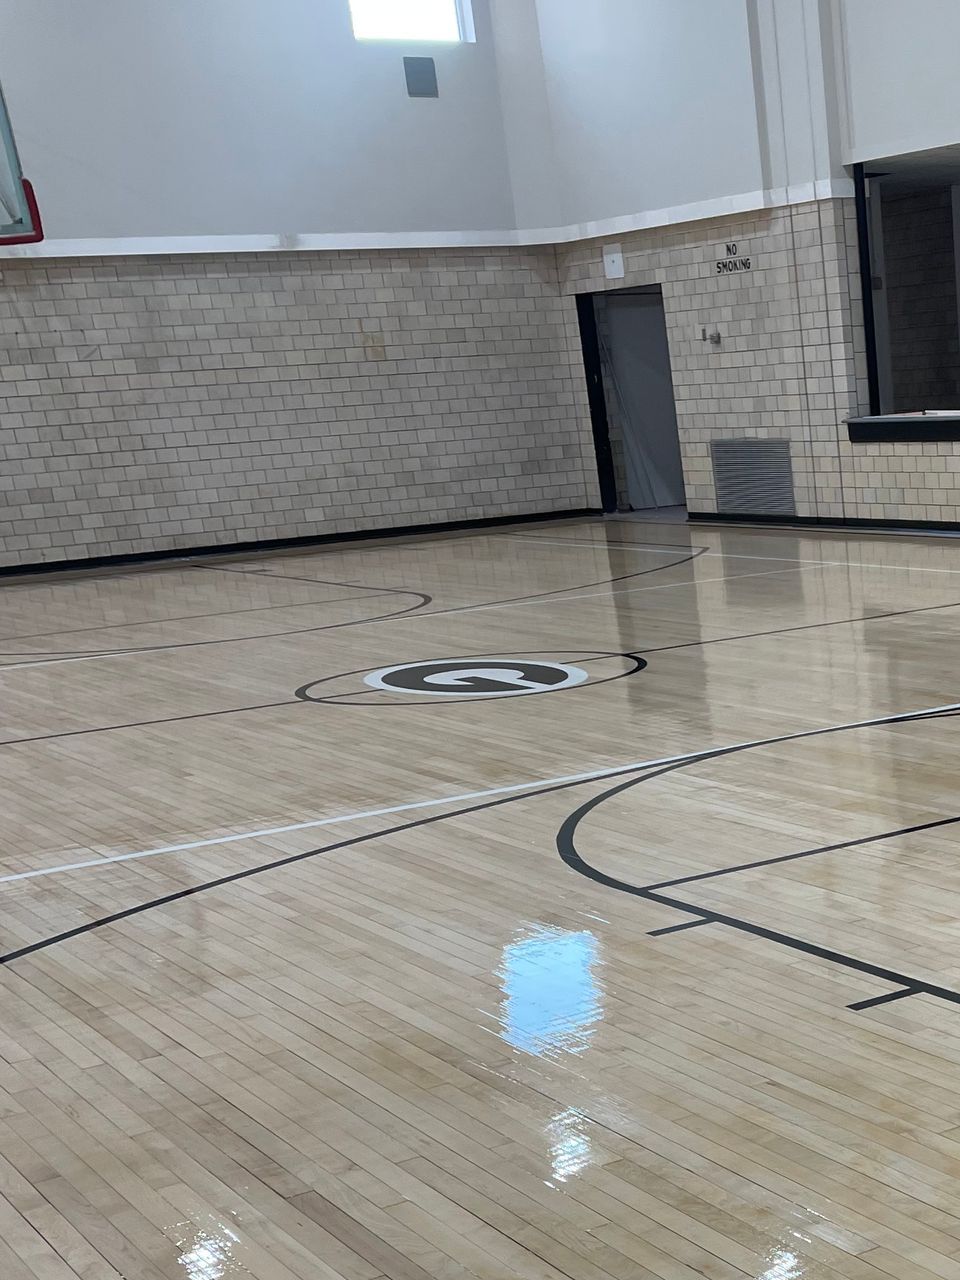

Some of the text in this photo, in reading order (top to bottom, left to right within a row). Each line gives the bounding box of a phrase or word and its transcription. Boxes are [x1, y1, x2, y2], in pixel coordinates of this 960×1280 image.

[726, 243, 737, 256] NO
[716, 258, 750, 273] SMOKING
[381, 661, 569, 693] G
